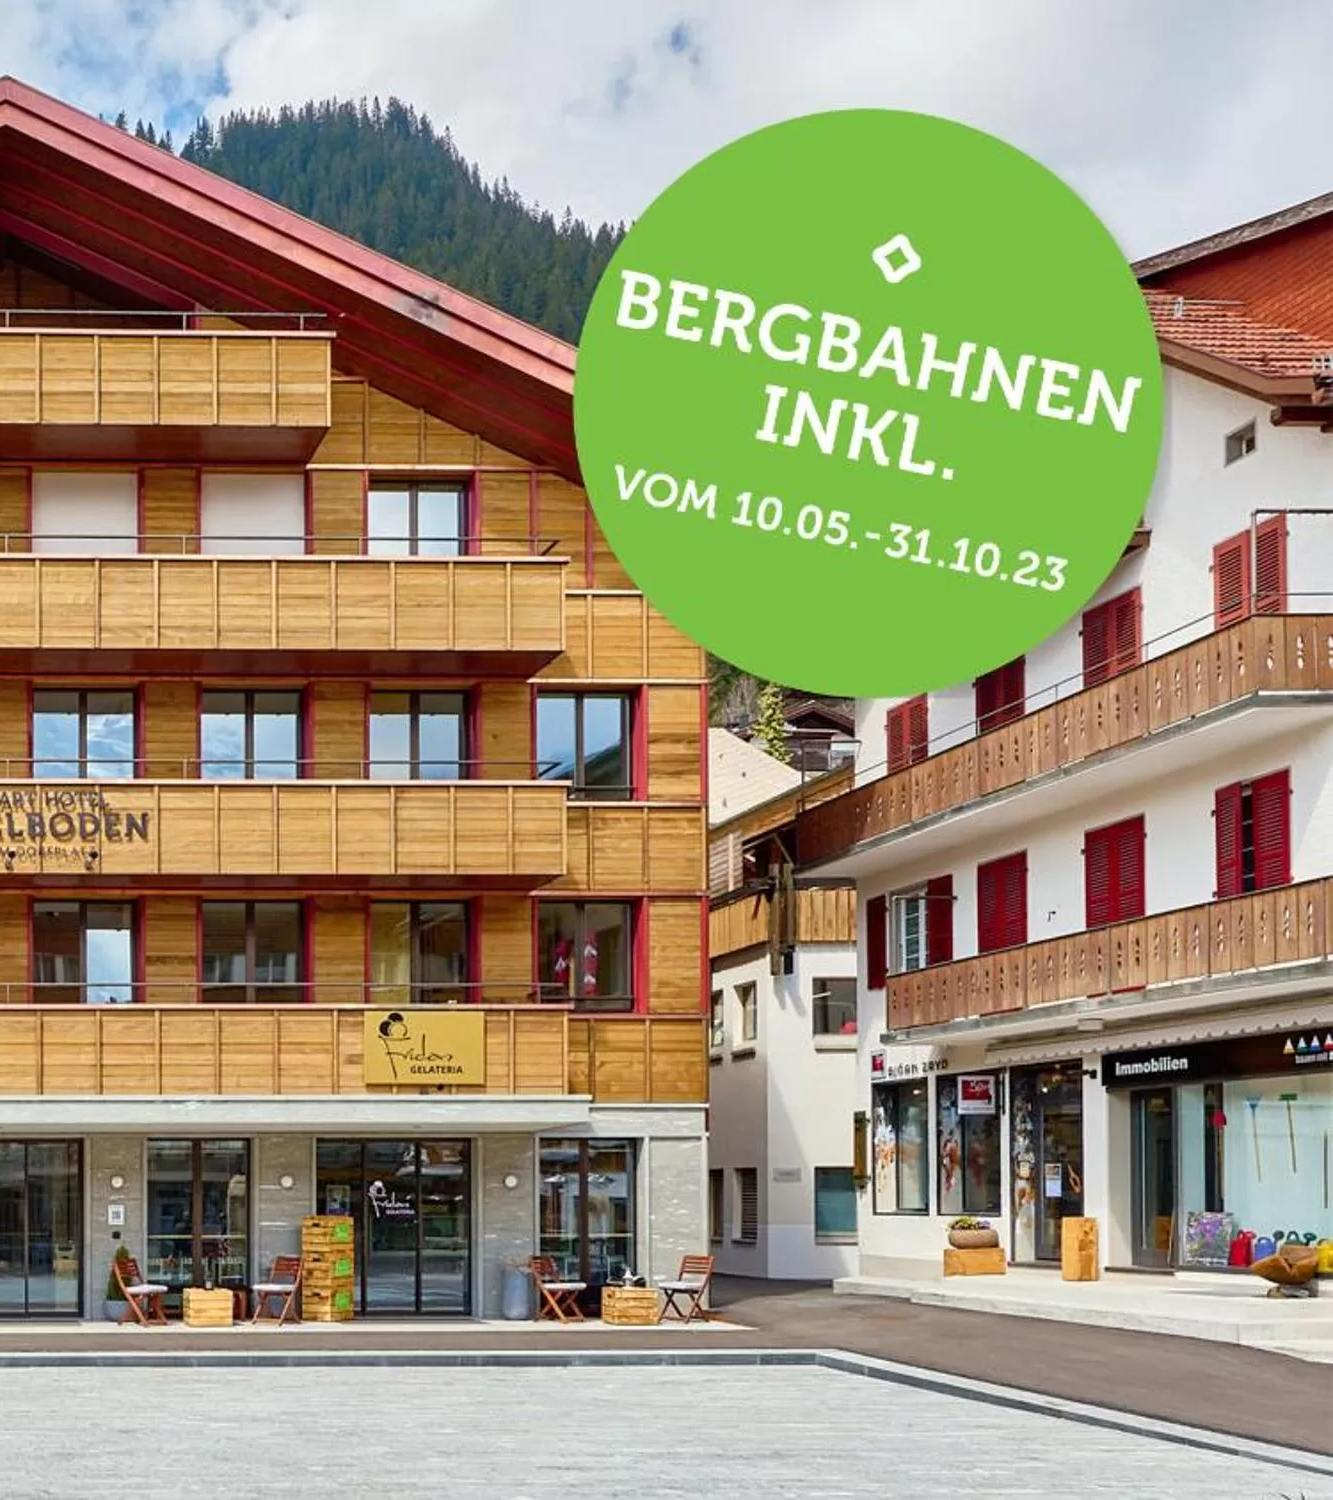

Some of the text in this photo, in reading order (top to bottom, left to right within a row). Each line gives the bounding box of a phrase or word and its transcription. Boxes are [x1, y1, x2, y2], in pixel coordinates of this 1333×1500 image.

[45, 790, 108, 809] HOTEL
[410, 1066, 463, 1074] GELATERIA
[1115, 1056, 1188, 1076] Immobilien
